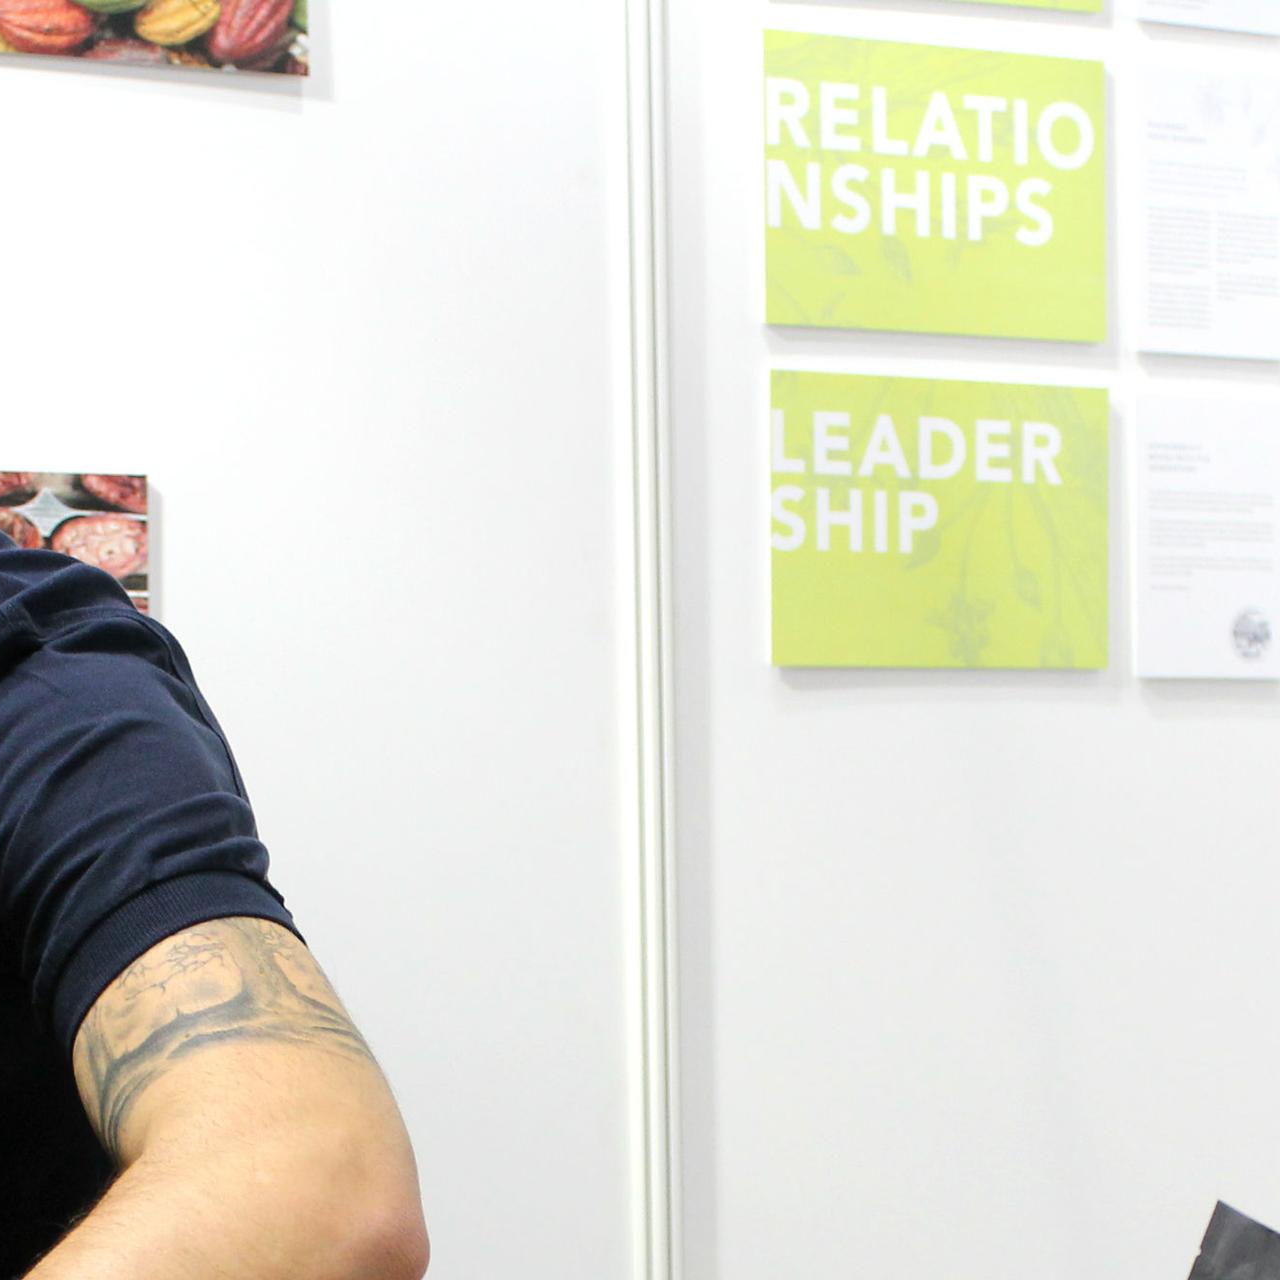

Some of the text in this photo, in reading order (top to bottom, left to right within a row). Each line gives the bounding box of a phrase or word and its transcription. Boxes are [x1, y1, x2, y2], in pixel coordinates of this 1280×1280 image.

[764, 76, 1095, 170] RELATIO
[765, 158, 1055, 247] NSHIPS
[771, 409, 1064, 486] LEADER
[771, 486, 939, 555] SHIP
